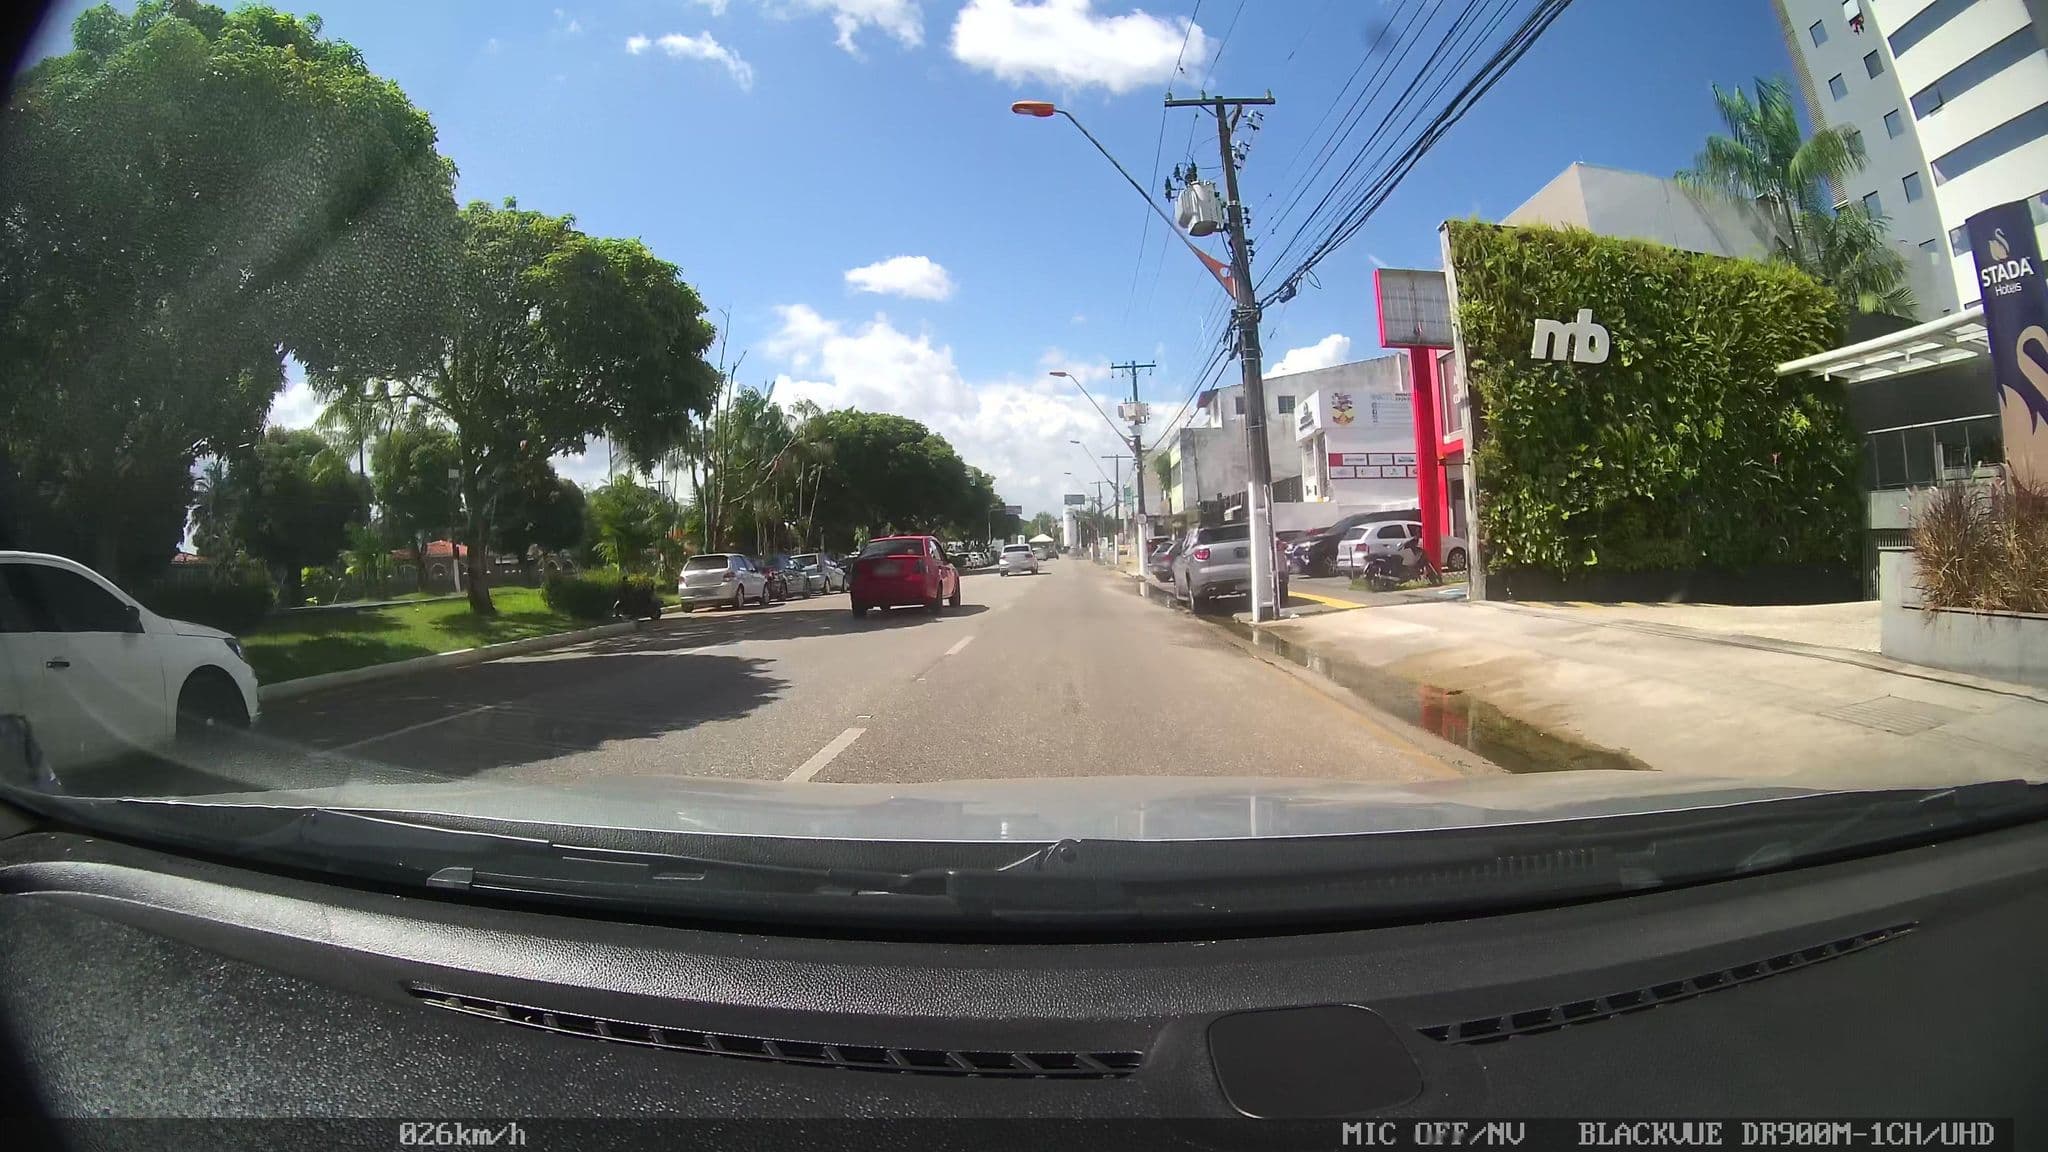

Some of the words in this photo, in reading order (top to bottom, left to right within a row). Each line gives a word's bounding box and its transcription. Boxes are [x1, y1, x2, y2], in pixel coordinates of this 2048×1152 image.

[1981, 257, 2034, 287] STADA
[1995, 282, 2022, 297] Hotels
[1531, 308, 1610, 364] mb
